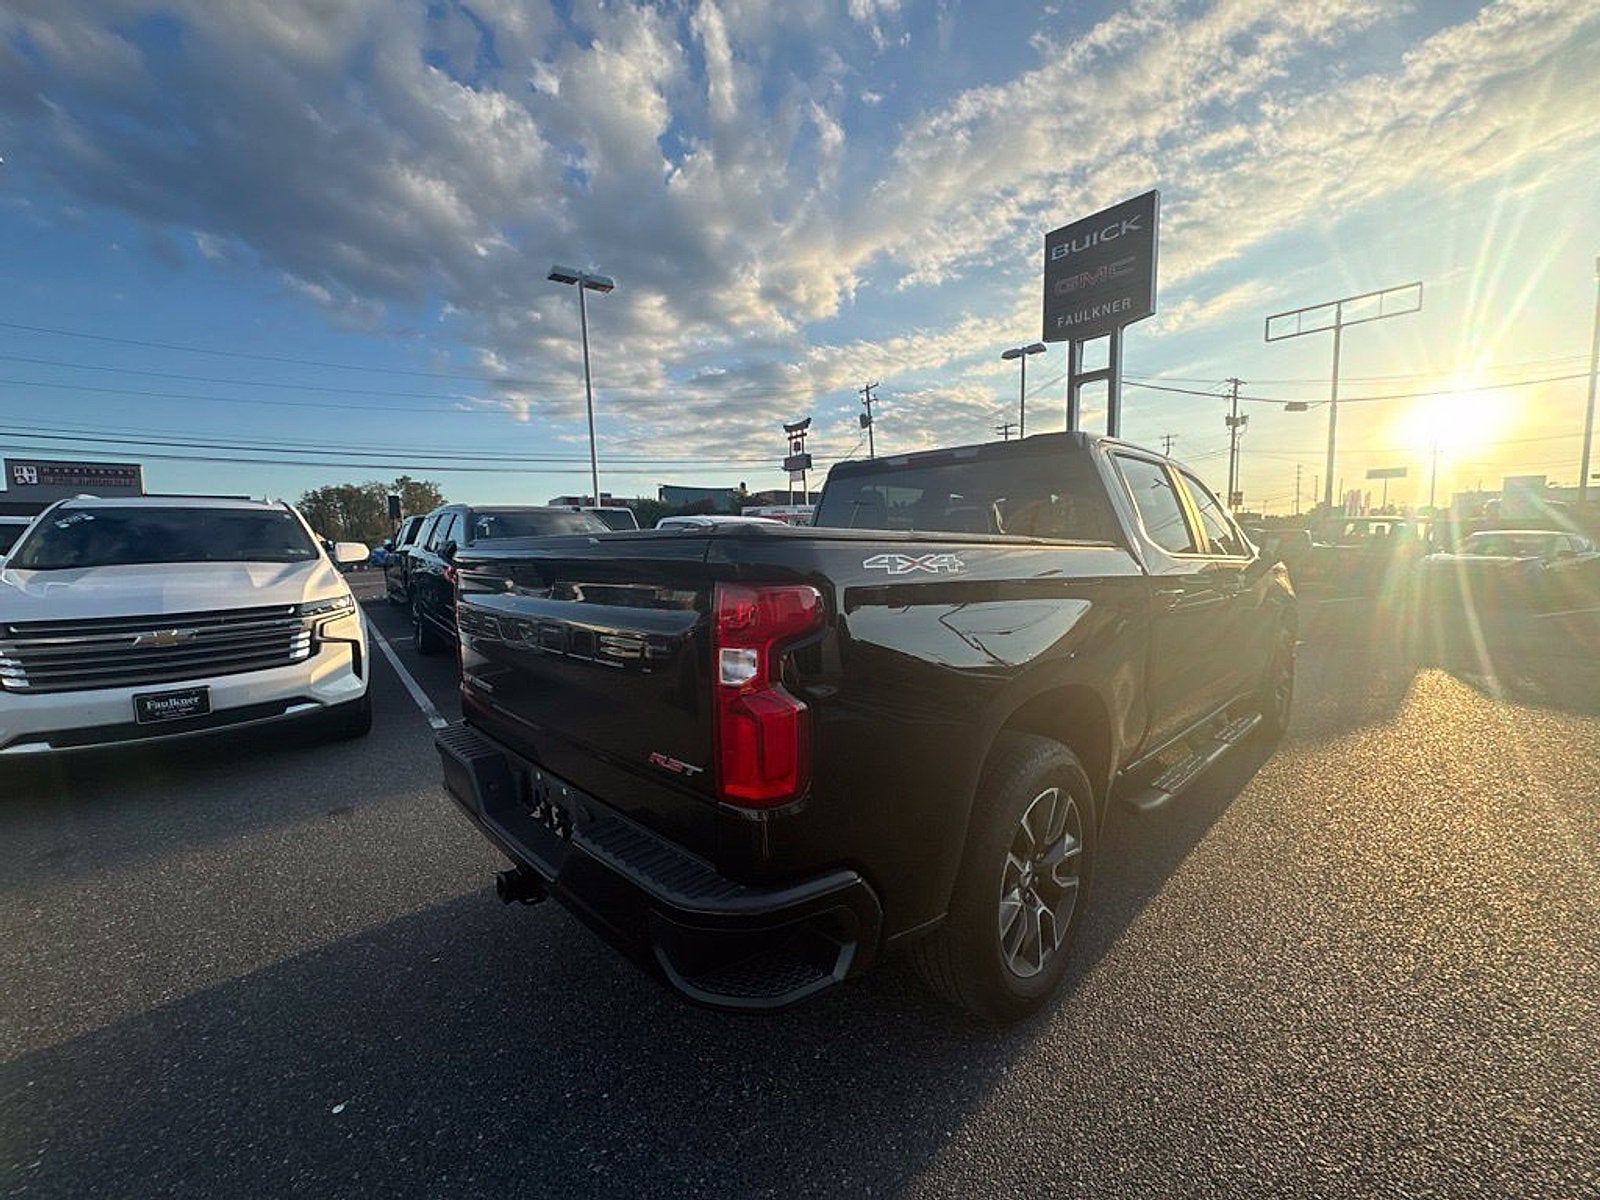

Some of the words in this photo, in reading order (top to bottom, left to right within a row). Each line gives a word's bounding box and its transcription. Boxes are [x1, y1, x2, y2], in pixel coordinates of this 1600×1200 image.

[1051, 214, 1142, 260] BUICK
[1054, 256, 1136, 296] GMC
[1057, 298, 1132, 328] FAULKNER
[146, 697, 199, 710] Faulkner
[649, 751, 703, 776] RST
